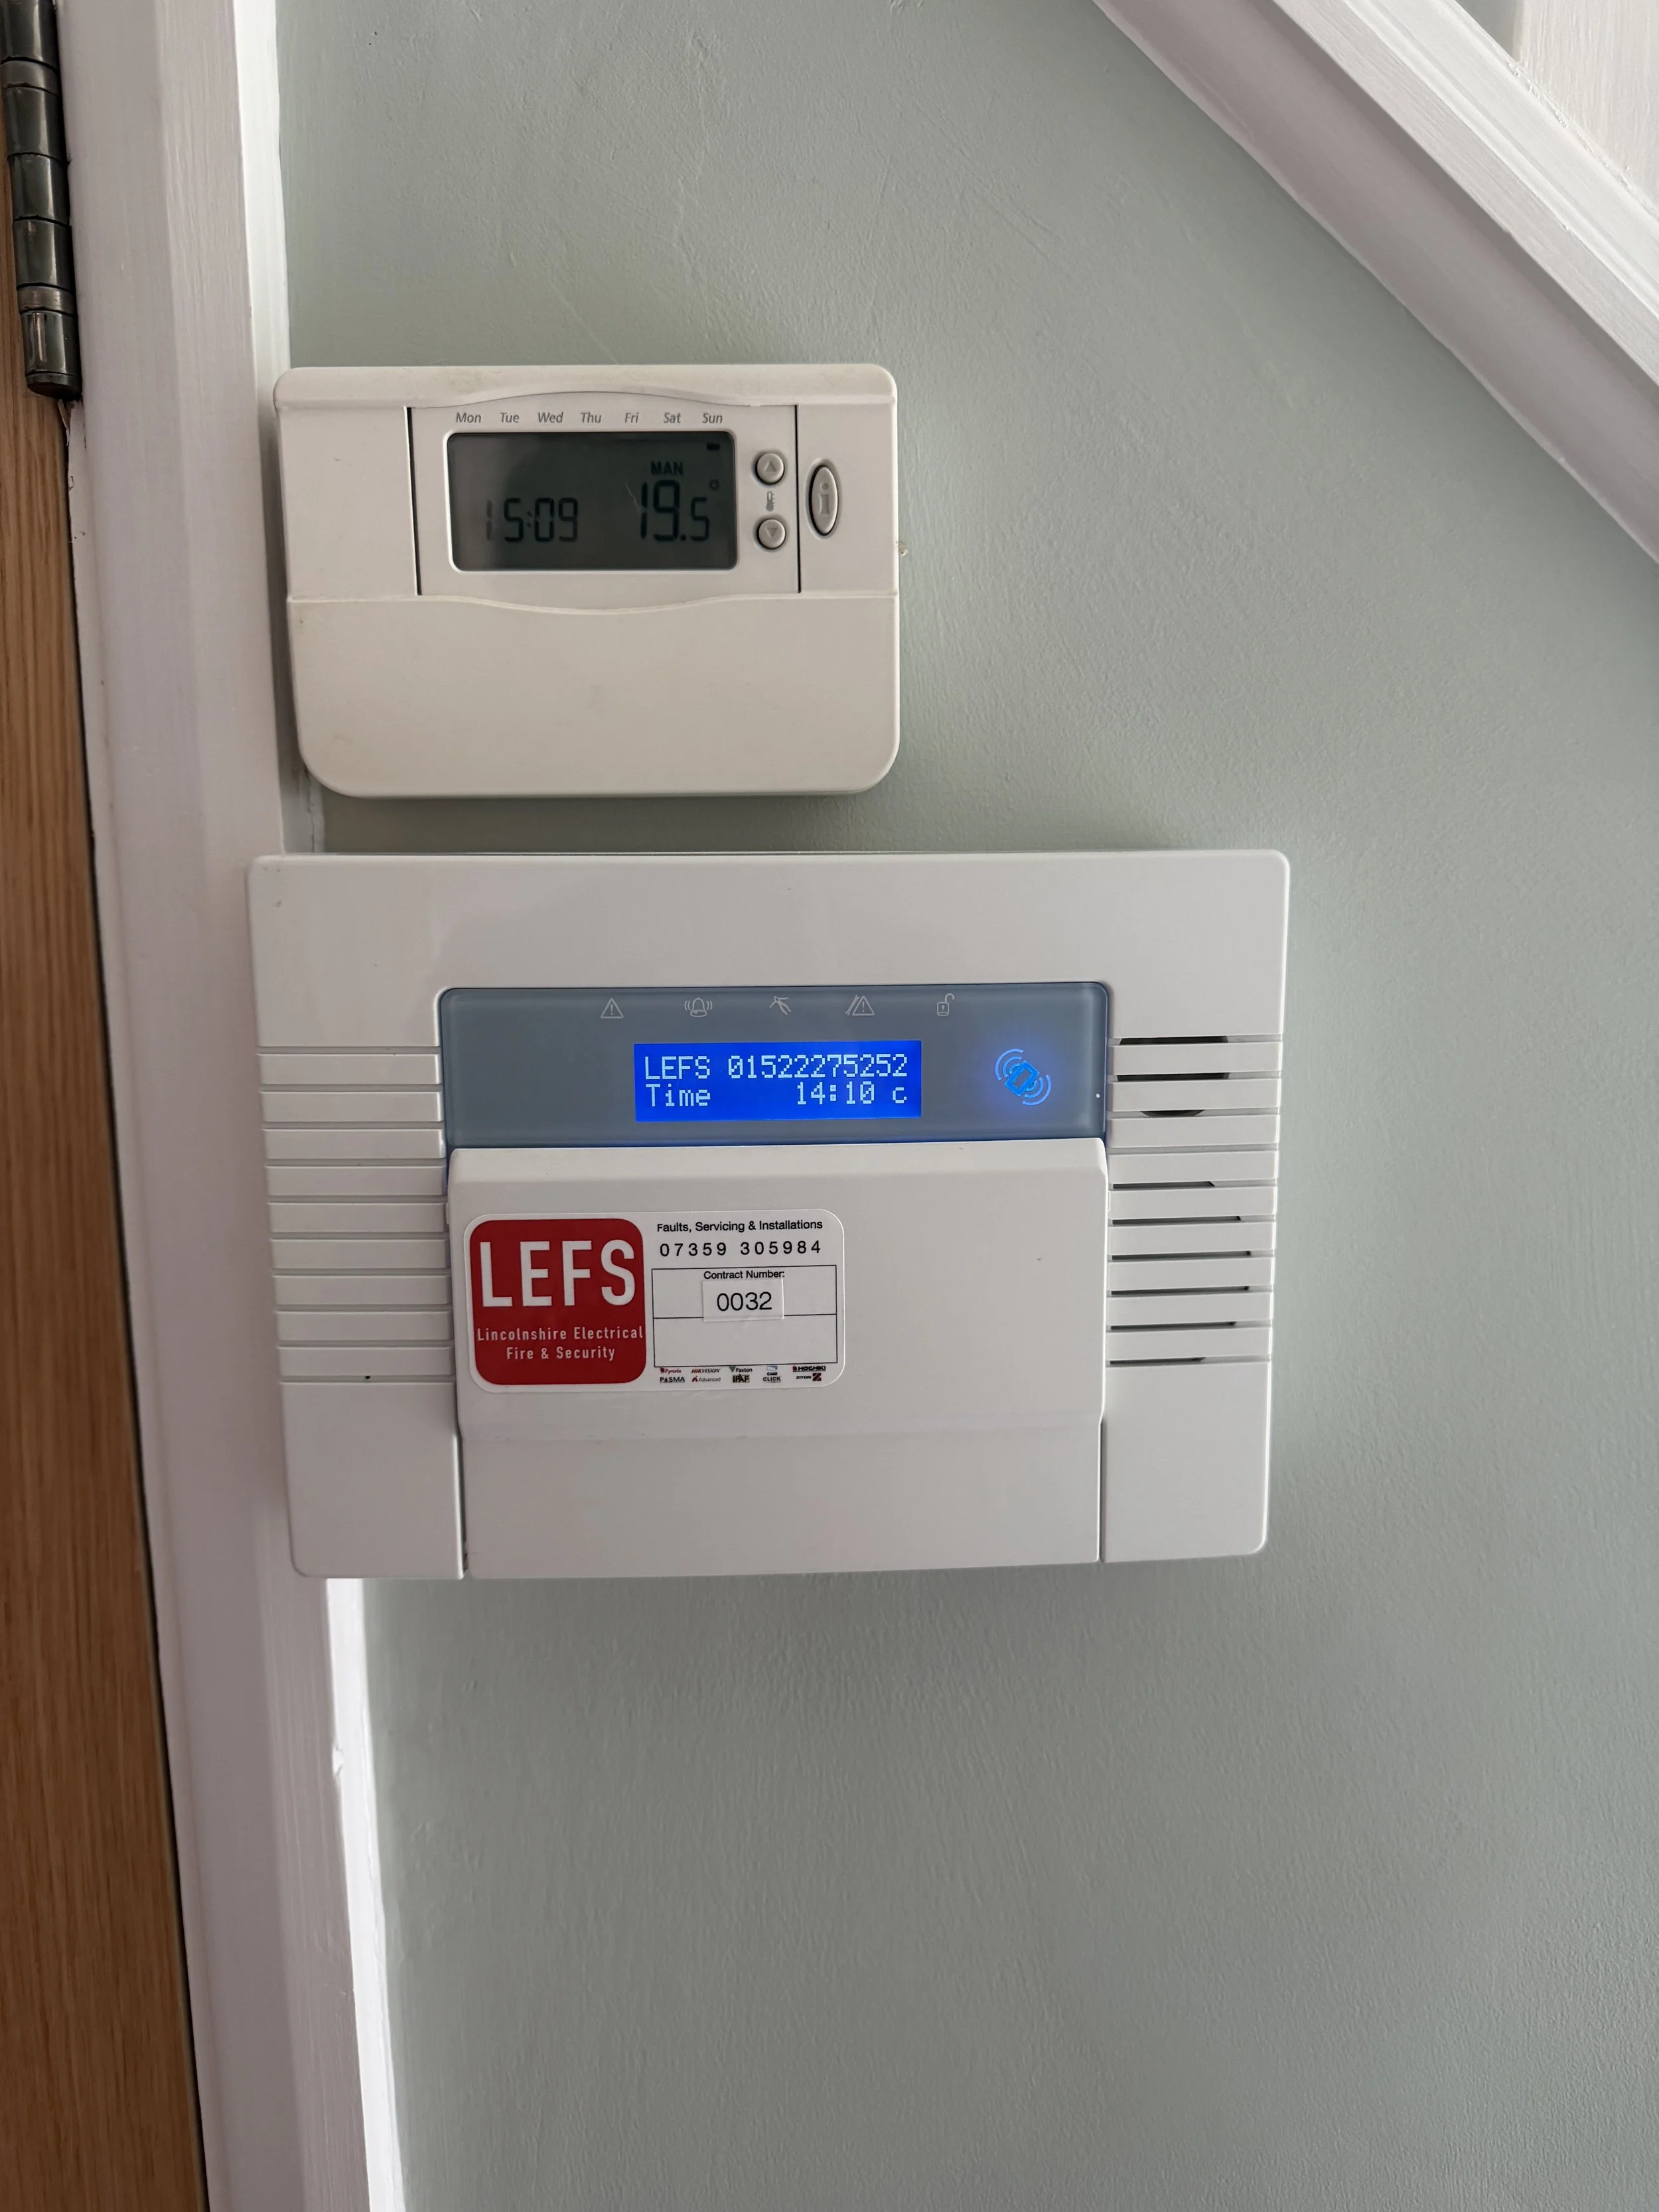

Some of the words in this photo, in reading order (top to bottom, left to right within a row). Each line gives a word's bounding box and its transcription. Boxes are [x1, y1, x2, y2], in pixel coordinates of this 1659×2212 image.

[455, 411, 482, 423] Mon
[499, 411, 520, 423] Tue
[538, 411, 564, 423] Wed
[581, 412, 602, 423] Thu
[624, 412, 639, 423] Fri
[663, 412, 681, 423] Sat
[701, 412, 723, 423] Sun
[650, 461, 684, 475] MAN
[485, 496, 579, 543] 15:09
[644, 1055, 711, 1080] LEFS
[728, 1053, 907, 1079] 01522275252
[646, 1084, 711, 1107] Time
[796, 1082, 875, 1105] 14:10
[656, 1222, 691, 1233] Faults,
[695, 1222, 745, 1233] Servicing
[748, 1221, 757, 1231] &
[759, 1219, 823, 1230] Installations
[660, 1242, 726, 1257] 07359
[740, 1240, 821, 1255] 305984
[480, 1239, 635, 1307] LEFS
[703, 1270, 743, 1280] Contract
[746, 1269, 785, 1279] Number:
[717, 1292, 772, 1311] 0032
[477, 1327, 567, 1341] Lincolnshire
[574, 1326, 642, 1339] Electrical
[506, 1346, 534, 1360] Fire
[541, 1347, 549, 1359] &
[556, 1346, 615, 1360] Security
